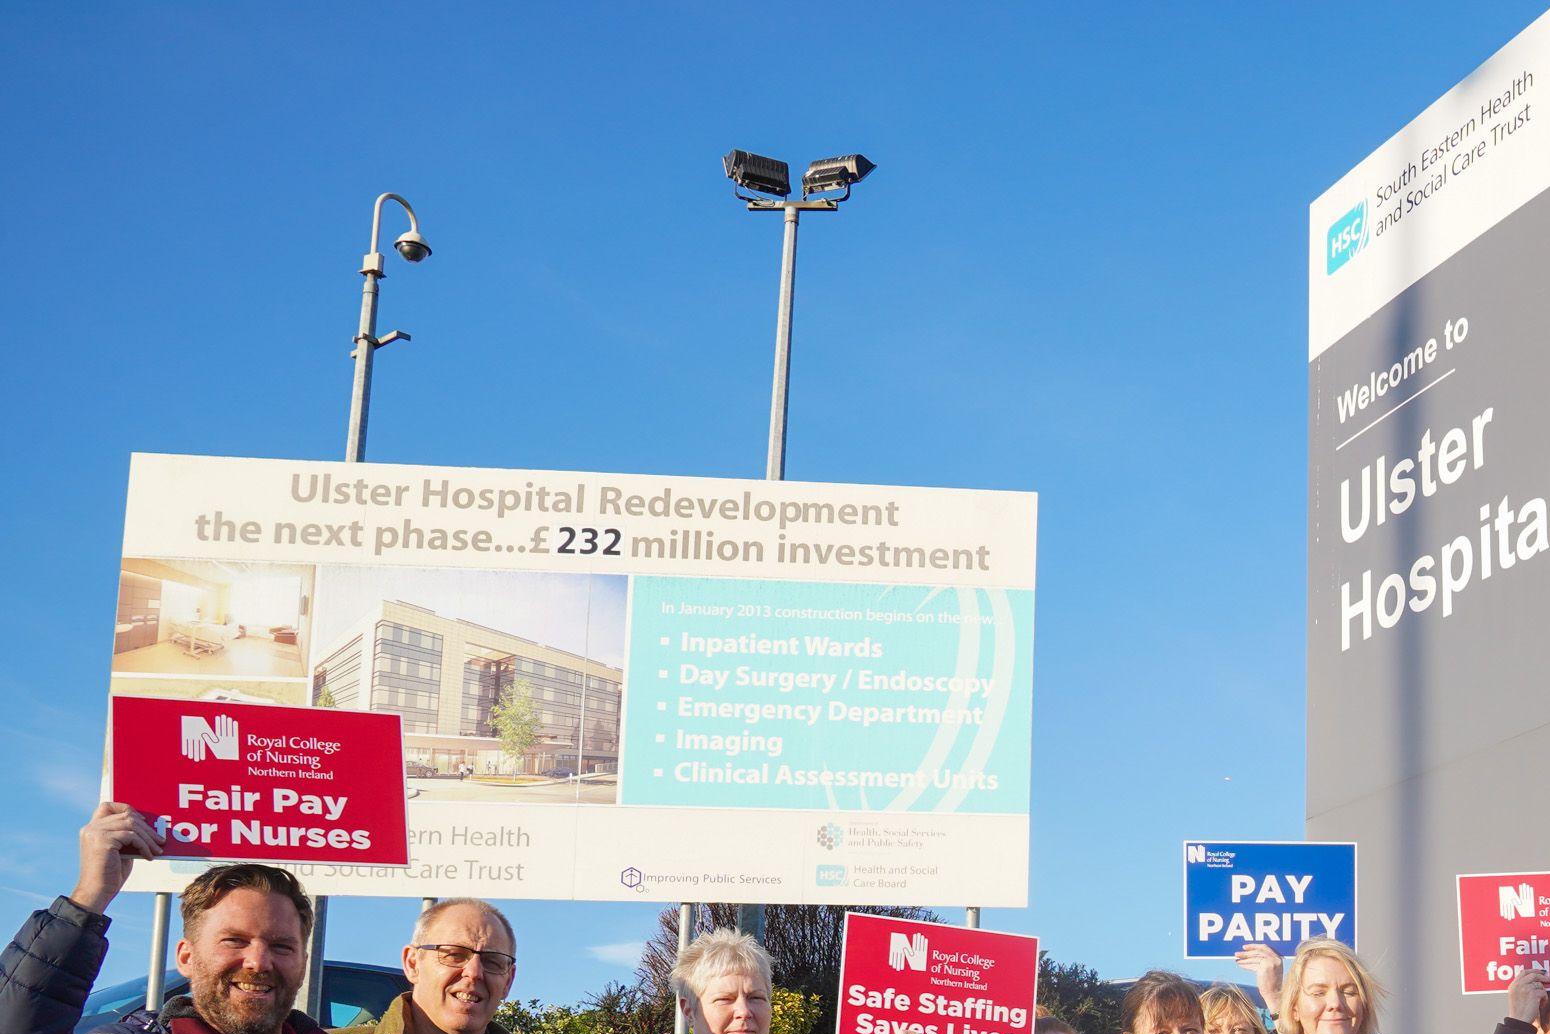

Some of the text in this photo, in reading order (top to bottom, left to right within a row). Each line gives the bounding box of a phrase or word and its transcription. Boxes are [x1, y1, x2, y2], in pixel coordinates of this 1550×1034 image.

[1375, 69, 1534, 208] South Eastern Health
[1375, 103, 1531, 238] and Social Care Trust
[1331, 219, 1360, 256] HSC
[1337, 316, 1469, 423] Welcome to
[1340, 407, 1494, 544] Ulster
[290, 474, 899, 529] Ulster Hospital Redevelopment
[195, 511, 262, 543] the
[274, 517, 363, 548] next
[631, 530, 764, 562] million
[777, 533, 990, 571] investment
[661, 601, 960, 624] In January 2013 construction begins on the
[681, 632, 883, 658] Inpatient Wards
[680, 664, 994, 698] Day Surgery Endoscopy
[678, 697, 983, 726] Emergency Department
[248, 734, 341, 754] Royal College
[676, 730, 783, 756] Imaging
[247, 751, 321, 768] of Nursing
[248, 767, 333, 780] Northern Ireland
[674, 762, 998, 790] Clinical Assessment Units
[179, 784, 348, 820] Fair Pay
[154, 816, 371, 849] for Nurses
[452, 827, 530, 848] Health
[404, 860, 524, 881] Care Trust
[643, 873, 782, 886] Improving Public Services
[852, 865, 938, 875] Health and Social
[852, 879, 907, 888] Care Board
[1232, 875, 1313, 903] PAY
[1200, 913, 1344, 941] PARITY
[1500, 936, 1548, 955] Fair
[848, 985, 1026, 1028] Safe Staffing
